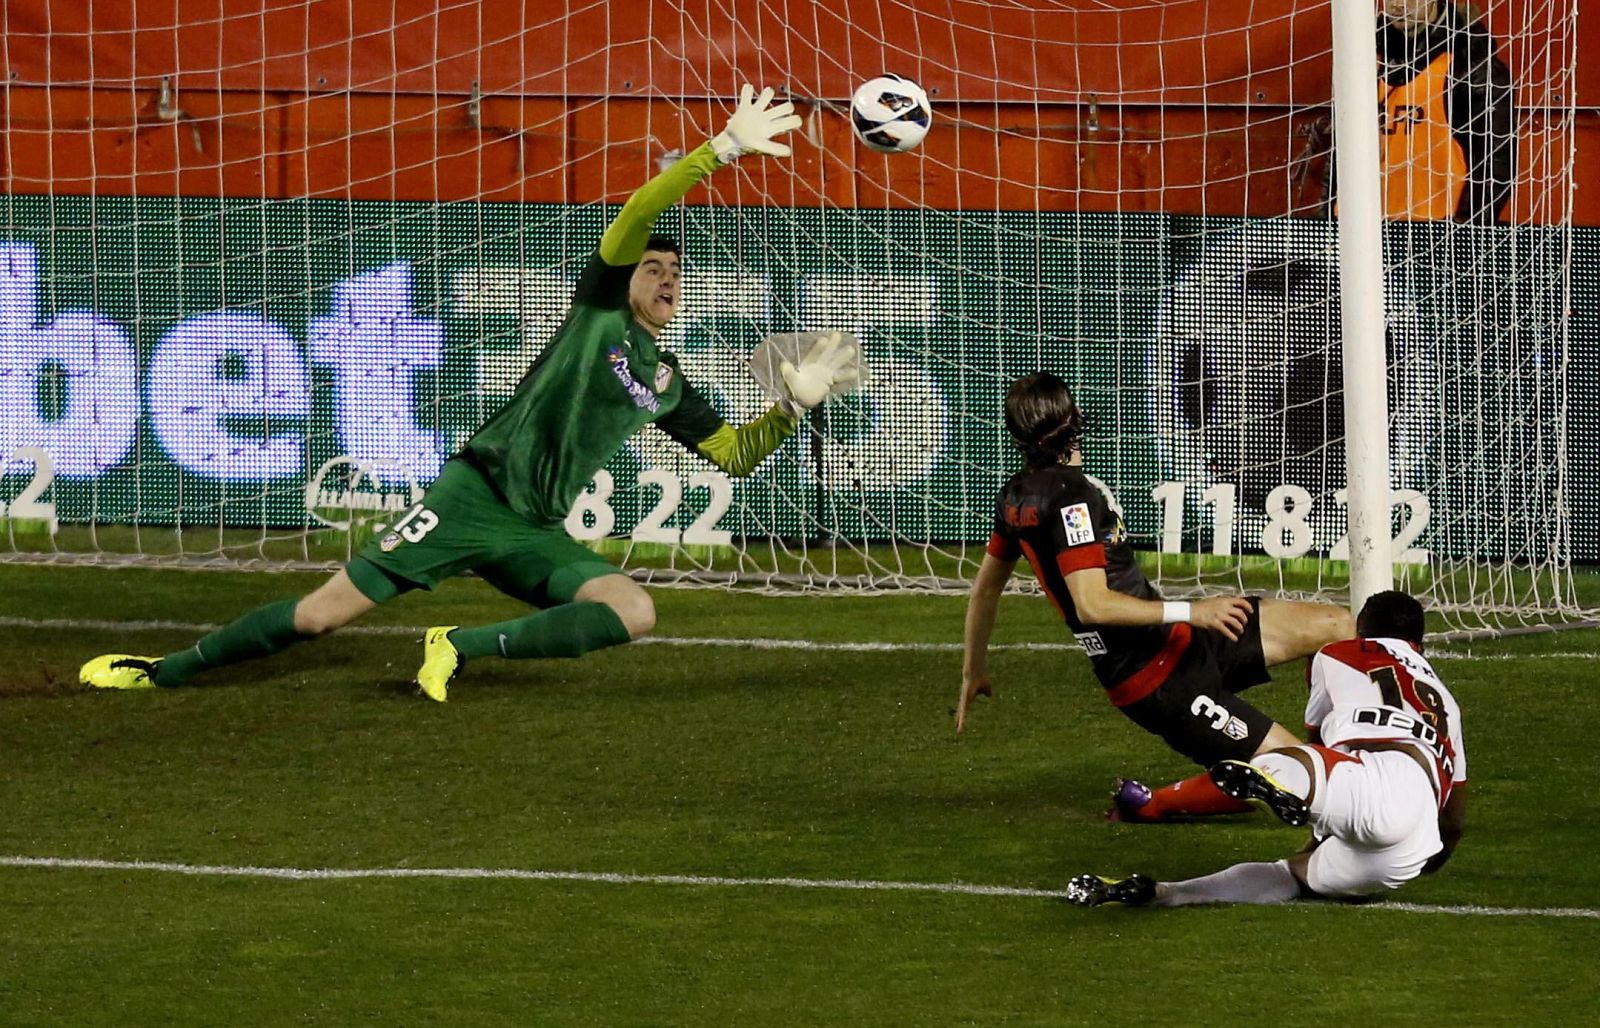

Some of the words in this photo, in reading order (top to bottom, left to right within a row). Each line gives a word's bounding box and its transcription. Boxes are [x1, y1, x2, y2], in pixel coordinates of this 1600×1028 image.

[393, 503, 439, 543] 13
[1070, 529, 1090, 544] LFP
[1190, 694, 1230, 731] 3
